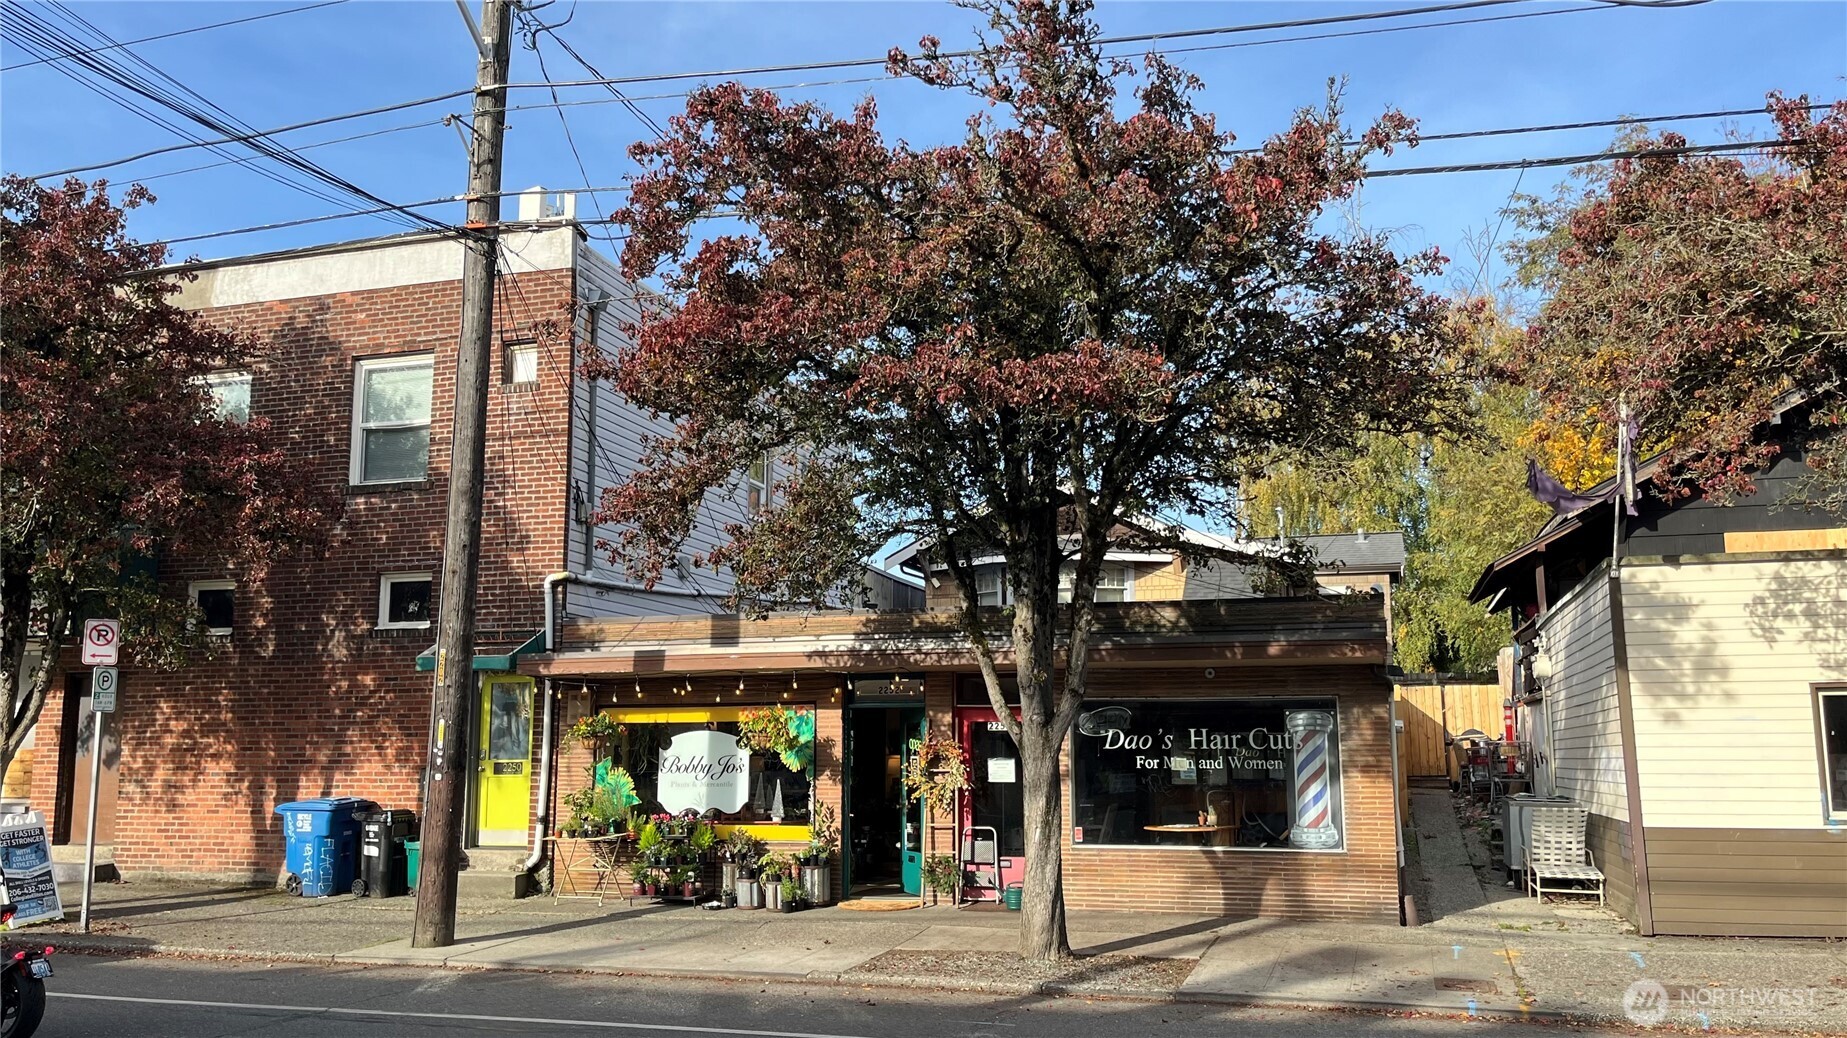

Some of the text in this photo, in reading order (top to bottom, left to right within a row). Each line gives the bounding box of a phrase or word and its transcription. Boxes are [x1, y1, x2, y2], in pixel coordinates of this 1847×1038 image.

[101, 675, 109, 686] P
[94, 691, 100, 699] 2
[1103, 728, 1174, 750] Dao's
[1188, 728, 1241, 750] Hair
[502, 762, 522, 772] 2250
[660, 755, 745, 781] Bobby Jo's
[1136, 755, 1159, 769] For
[1198, 755, 1224, 769] and
[1228, 755, 1284, 770] Women
[1, 829, 40, 840] GET FASTER
[0, 835, 44, 848] GET STRONGER
[12, 854, 37, 862] COLLEGE
[12, 860, 40, 868] ATHLETES
[9, 883, 54, 896] 206-432-7030
[26, 906, 42, 916] FREE
